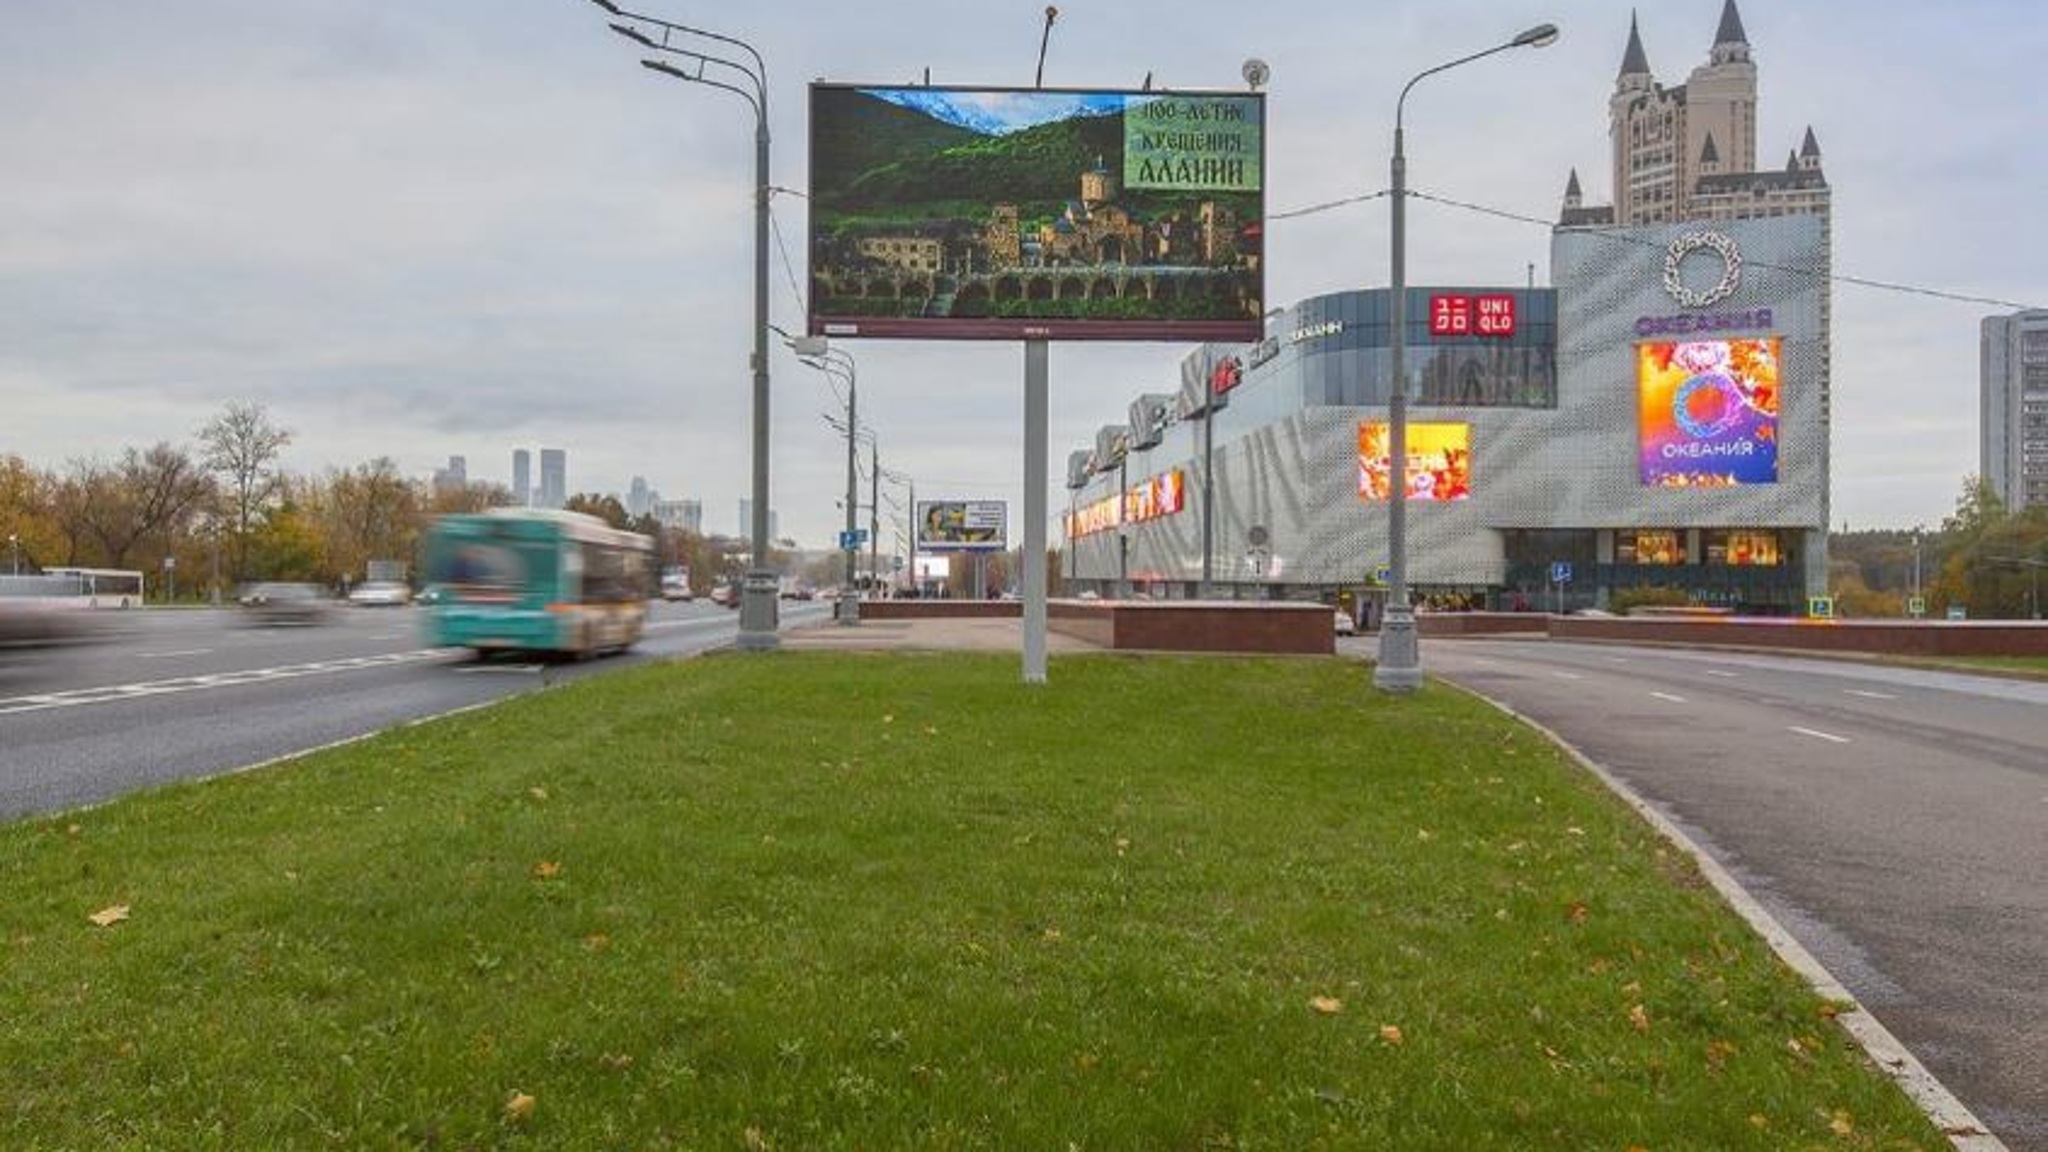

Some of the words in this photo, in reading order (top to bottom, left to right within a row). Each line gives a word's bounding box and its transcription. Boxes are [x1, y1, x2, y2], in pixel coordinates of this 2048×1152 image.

[1141, 132, 1241, 152] КРЕЩЕНИЯ
[1139, 158, 1243, 184] АЛАНИИ
[1479, 299, 1510, 314] UNI
[1479, 315, 1511, 333] QLO
[1662, 441, 1753, 458] ОКЕАНИЯ
